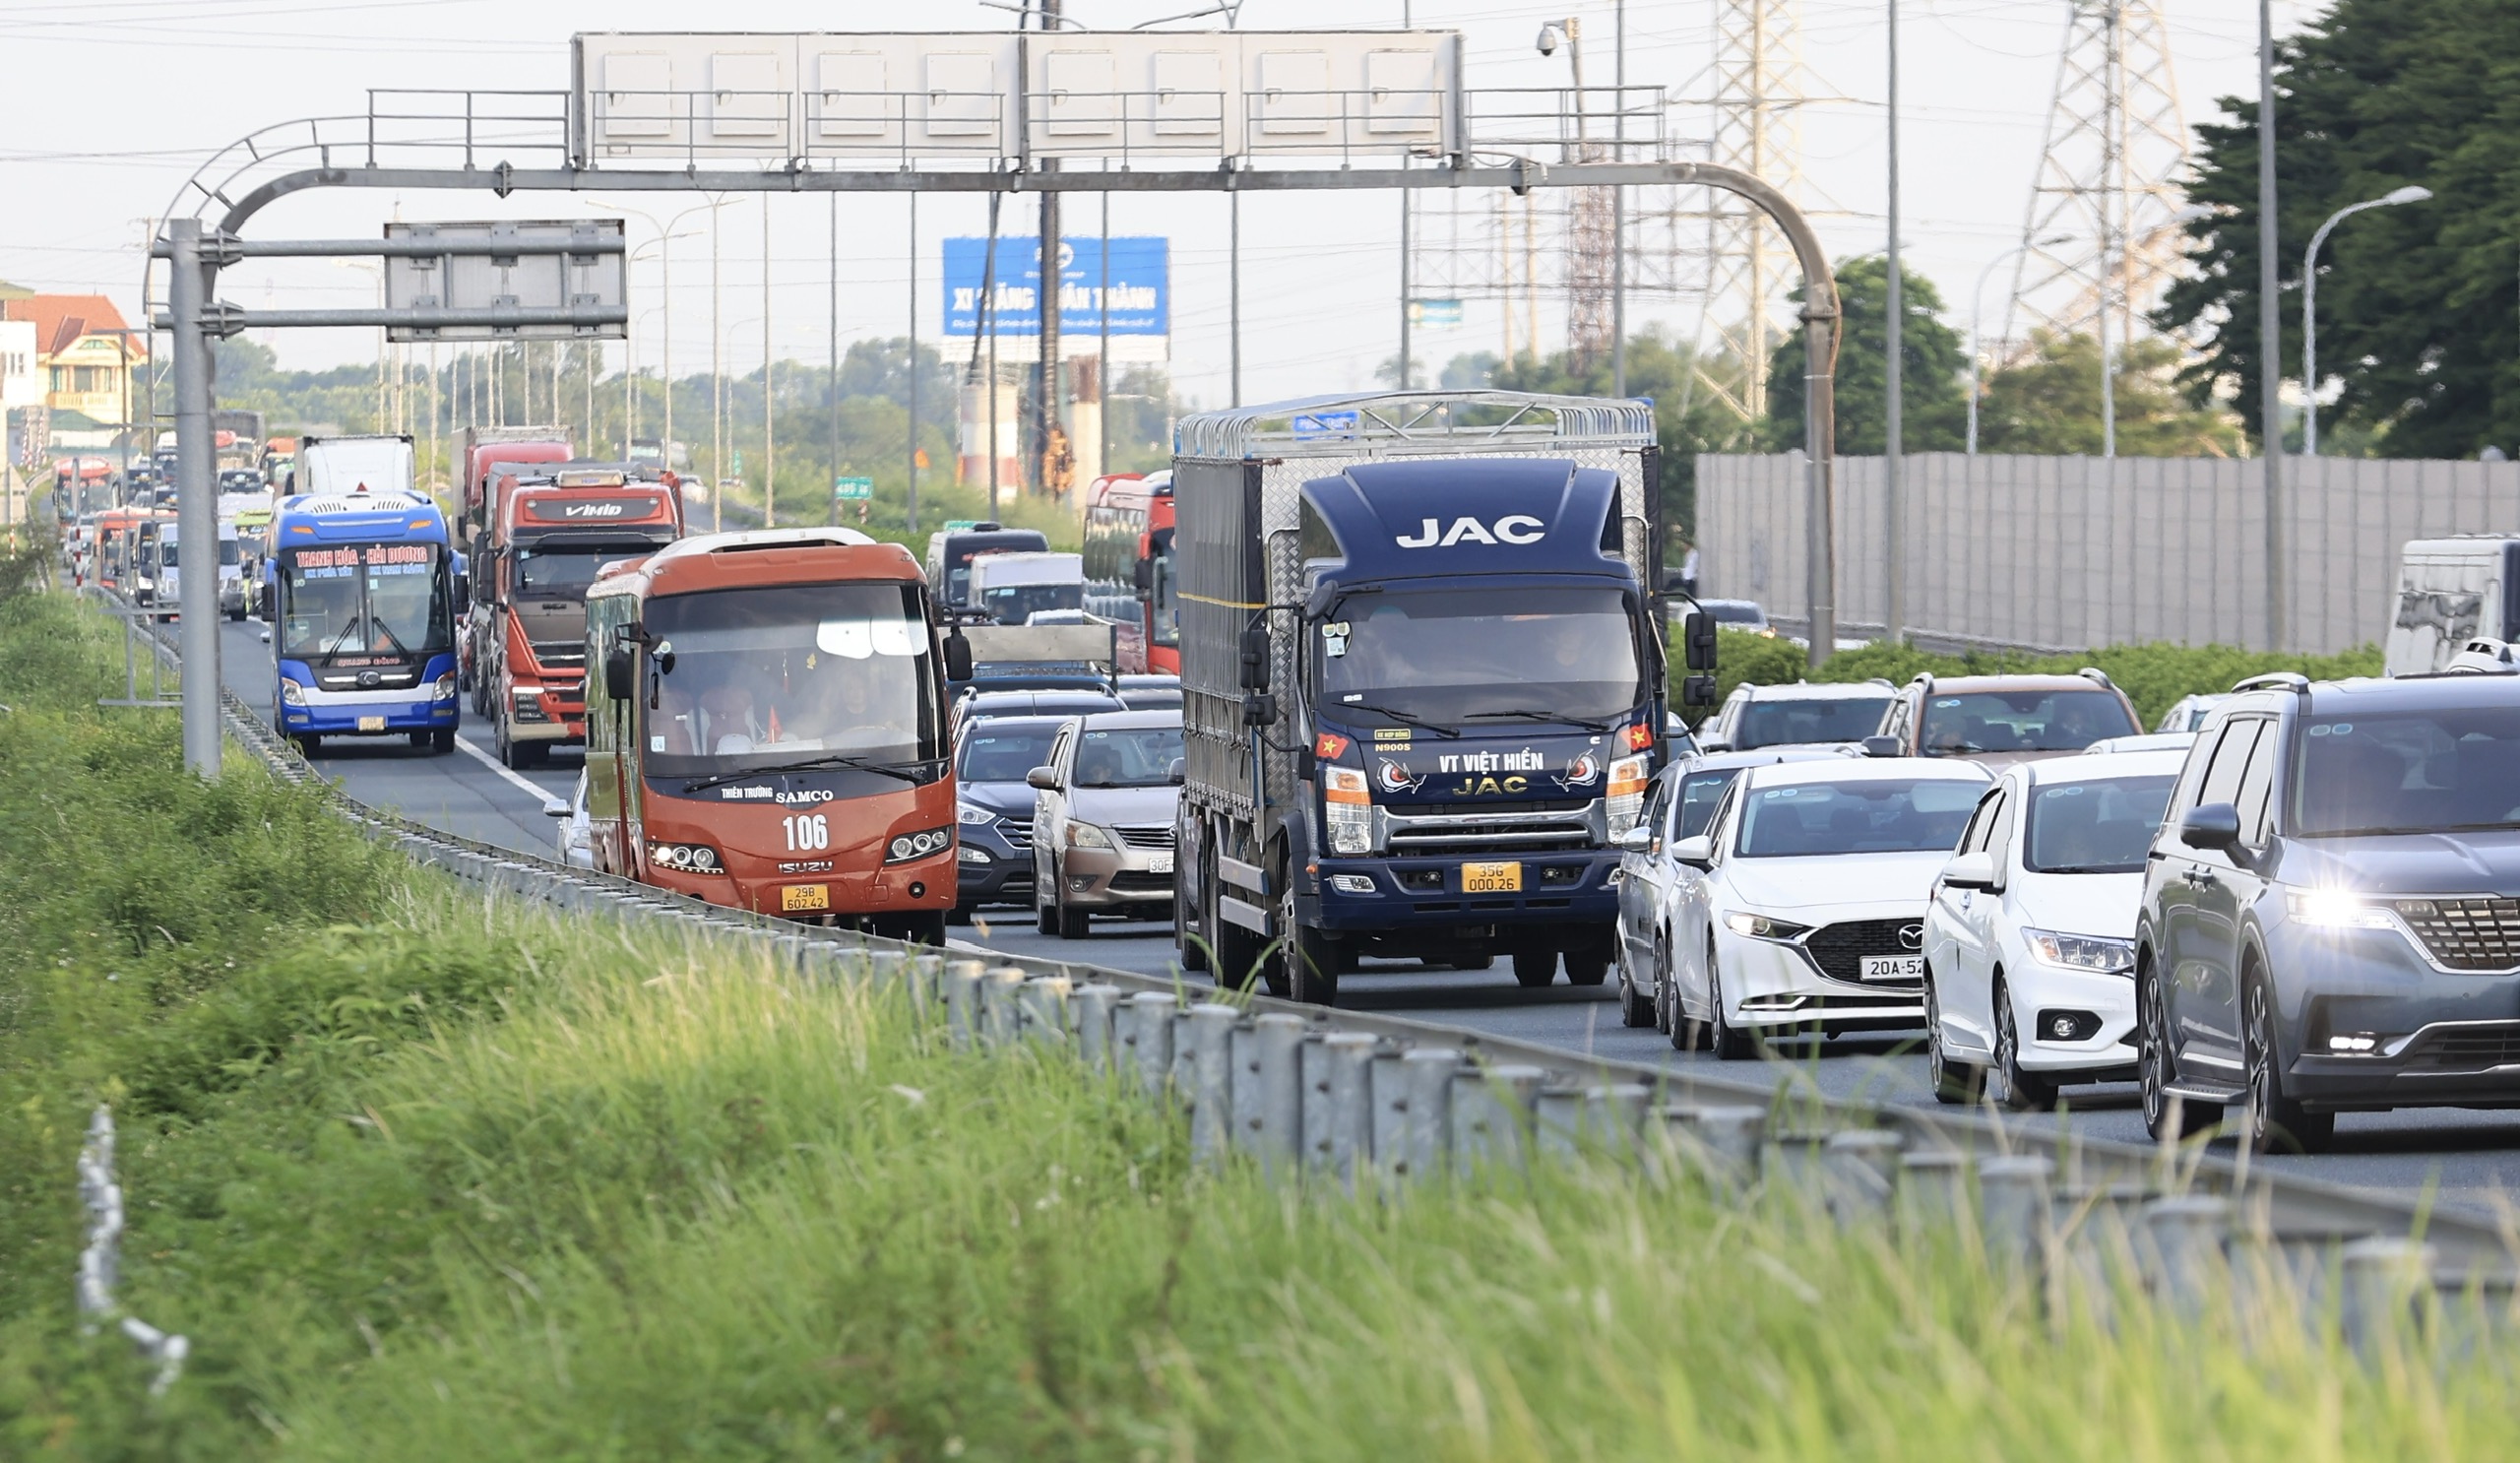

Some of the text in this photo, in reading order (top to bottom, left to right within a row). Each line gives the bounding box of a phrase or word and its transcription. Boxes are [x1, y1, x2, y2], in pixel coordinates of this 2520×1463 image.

[1396, 515, 1545, 548] JAC
[296, 551, 334, 567] THANH
[335, 545, 359, 565] HÓA
[366, 543, 387, 564] HẢI
[1375, 743, 1411, 752] N900S
[1439, 746, 1544, 775] VT VIỆT HIỀN
[722, 785, 773, 798] THIÊN TRƯỜNG
[1452, 776, 1528, 796] JAC
[776, 790, 834, 803] SAMCO
[783, 814, 828, 851] 106
[779, 860, 833, 873] ISUZU
[1469, 878, 1514, 891] 000.26
[795, 887, 815, 898] 29B
[788, 897, 824, 909] 602.42
